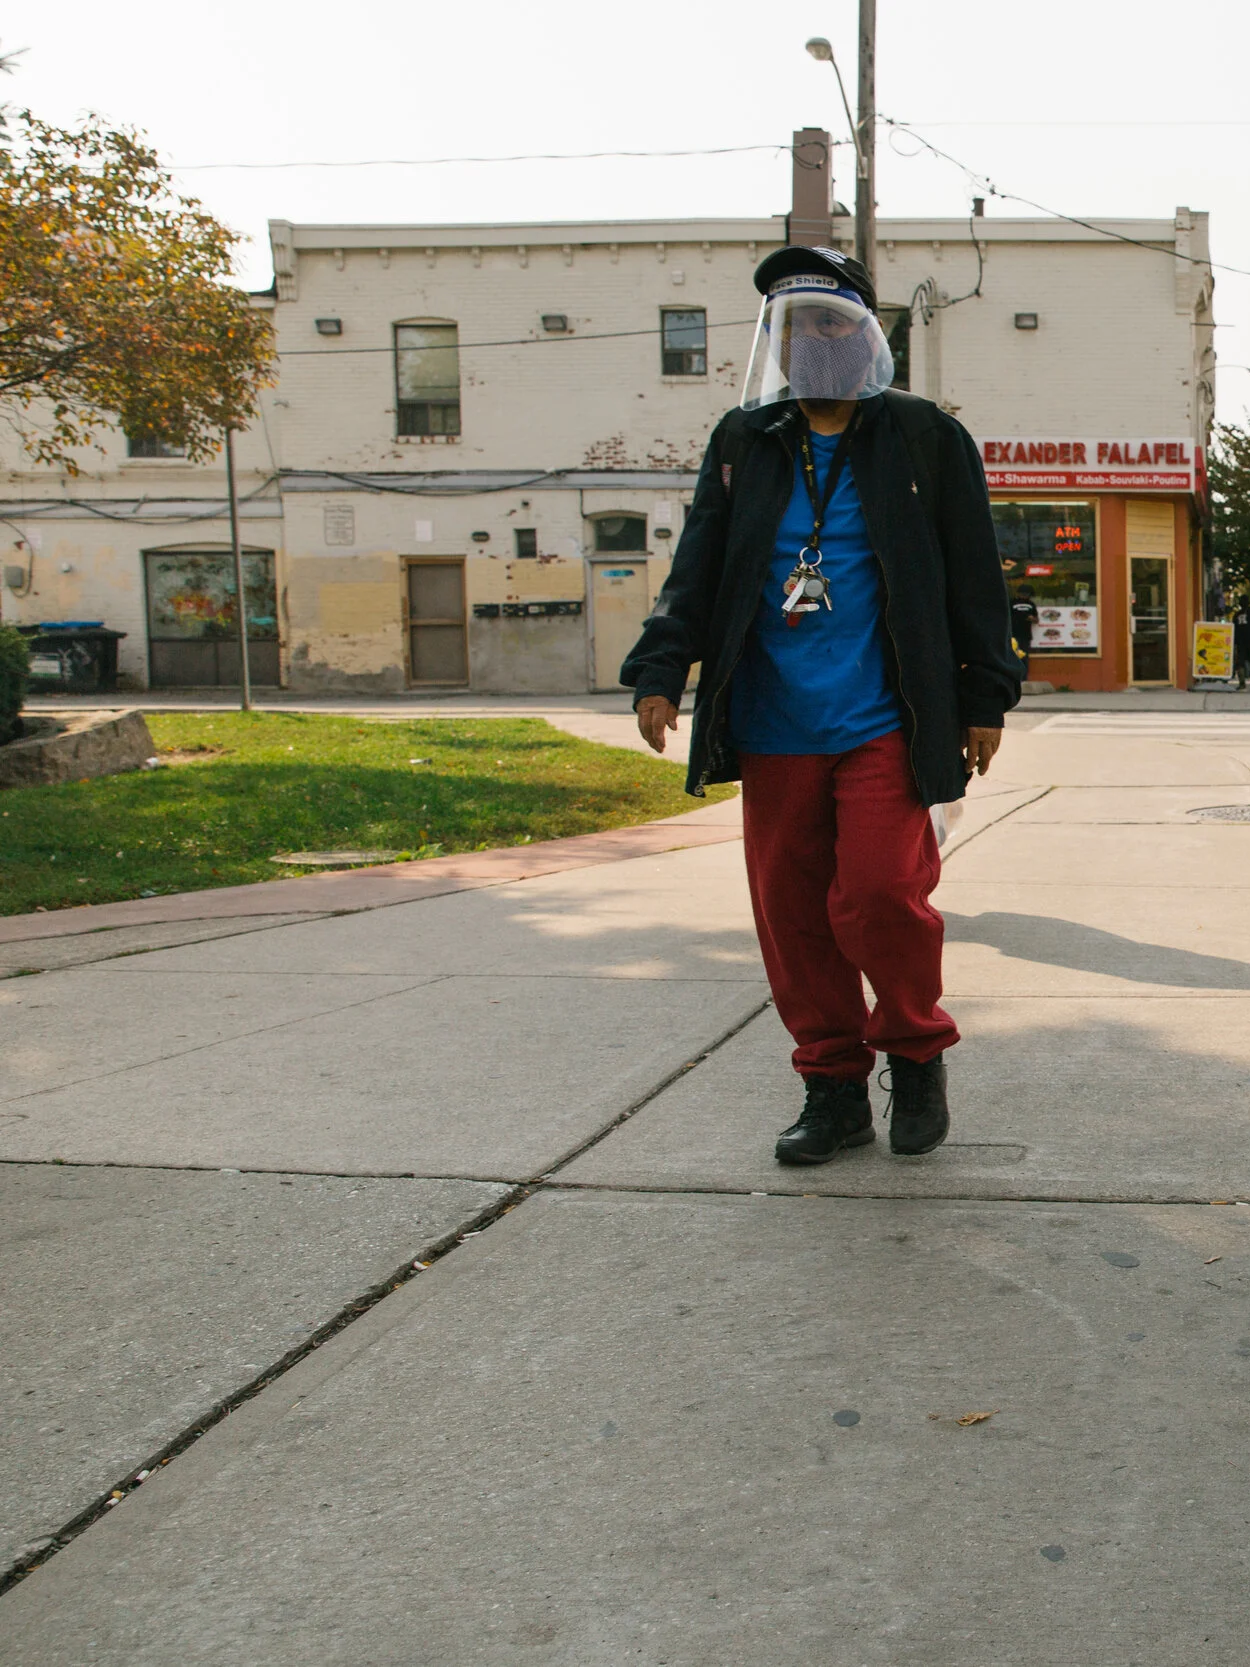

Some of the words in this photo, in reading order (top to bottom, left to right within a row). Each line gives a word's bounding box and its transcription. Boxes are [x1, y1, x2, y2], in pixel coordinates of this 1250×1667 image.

[795, 277, 834, 286] Shield
[983, 441, 1087, 465] EXANDER
[1097, 442, 1190, 465] FALAFEL
[1055, 527, 1080, 537] ATM
[1055, 543, 1081, 551] OPEN
